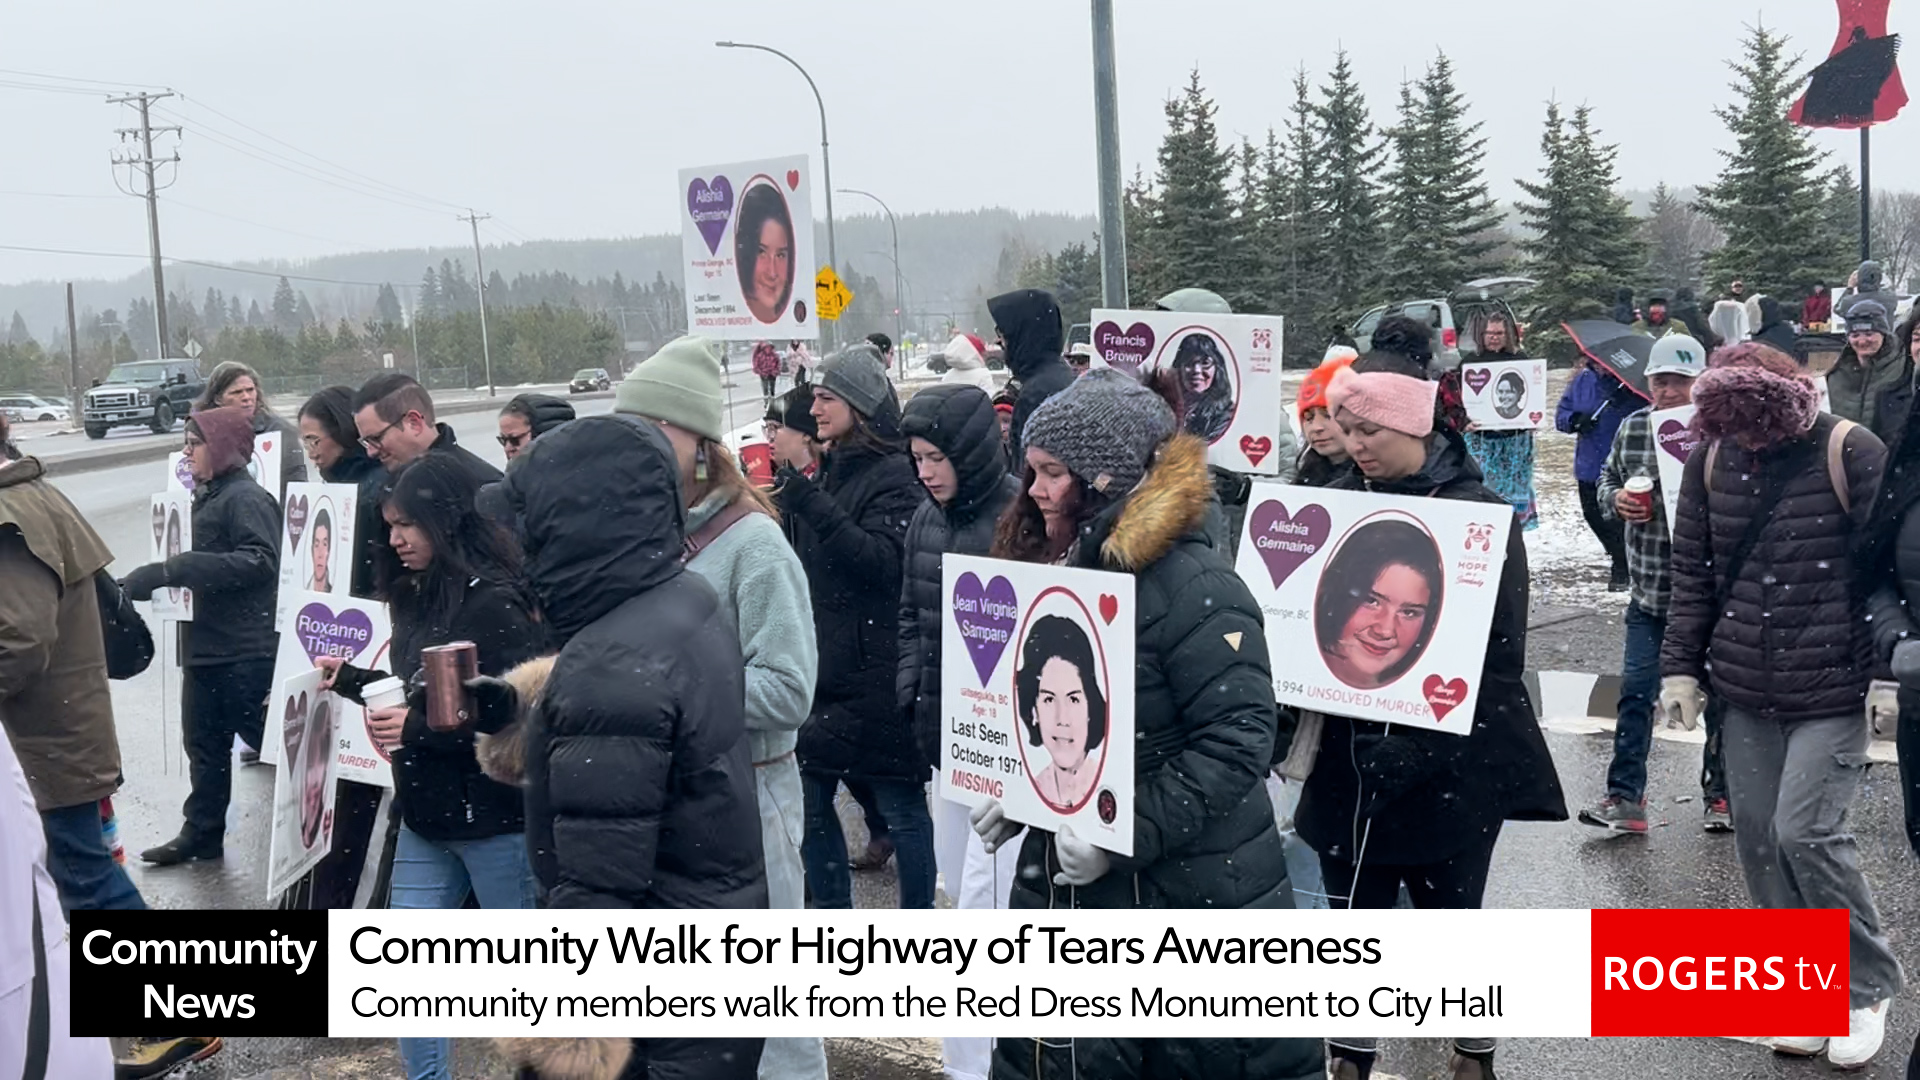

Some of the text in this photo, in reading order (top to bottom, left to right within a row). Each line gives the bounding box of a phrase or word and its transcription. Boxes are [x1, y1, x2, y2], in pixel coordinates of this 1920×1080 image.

[696, 188, 723, 203] Alishia
[692, 209, 729, 222] Germaine
[694, 293, 720, 302] Last Seen
[695, 305, 721, 314] December
[696, 316, 753, 326] UNSOLVED MURDER
[1103, 332, 1146, 347] Francis
[1105, 349, 1142, 363] Brown
[1659, 429, 1692, 443] Destin
[1268, 519, 1309, 536] Alishia
[1257, 535, 1316, 554] Germaine
[1457, 561, 1488, 571] HOPE
[953, 593, 1017, 620] Jean Virginia
[1297, 609, 1310, 620] BC
[298, 614, 368, 641] Roxanne
[962, 620, 1008, 644] Sampare
[305, 634, 355, 659] Thiara
[1276, 680, 1431, 717] 1994 UNSOLVED MURDER
[951, 716, 1008, 747] Last Seen
[339, 739, 351, 750] 94
[951, 743, 1023, 777] October 1971
[951, 769, 1004, 798] MISSING
